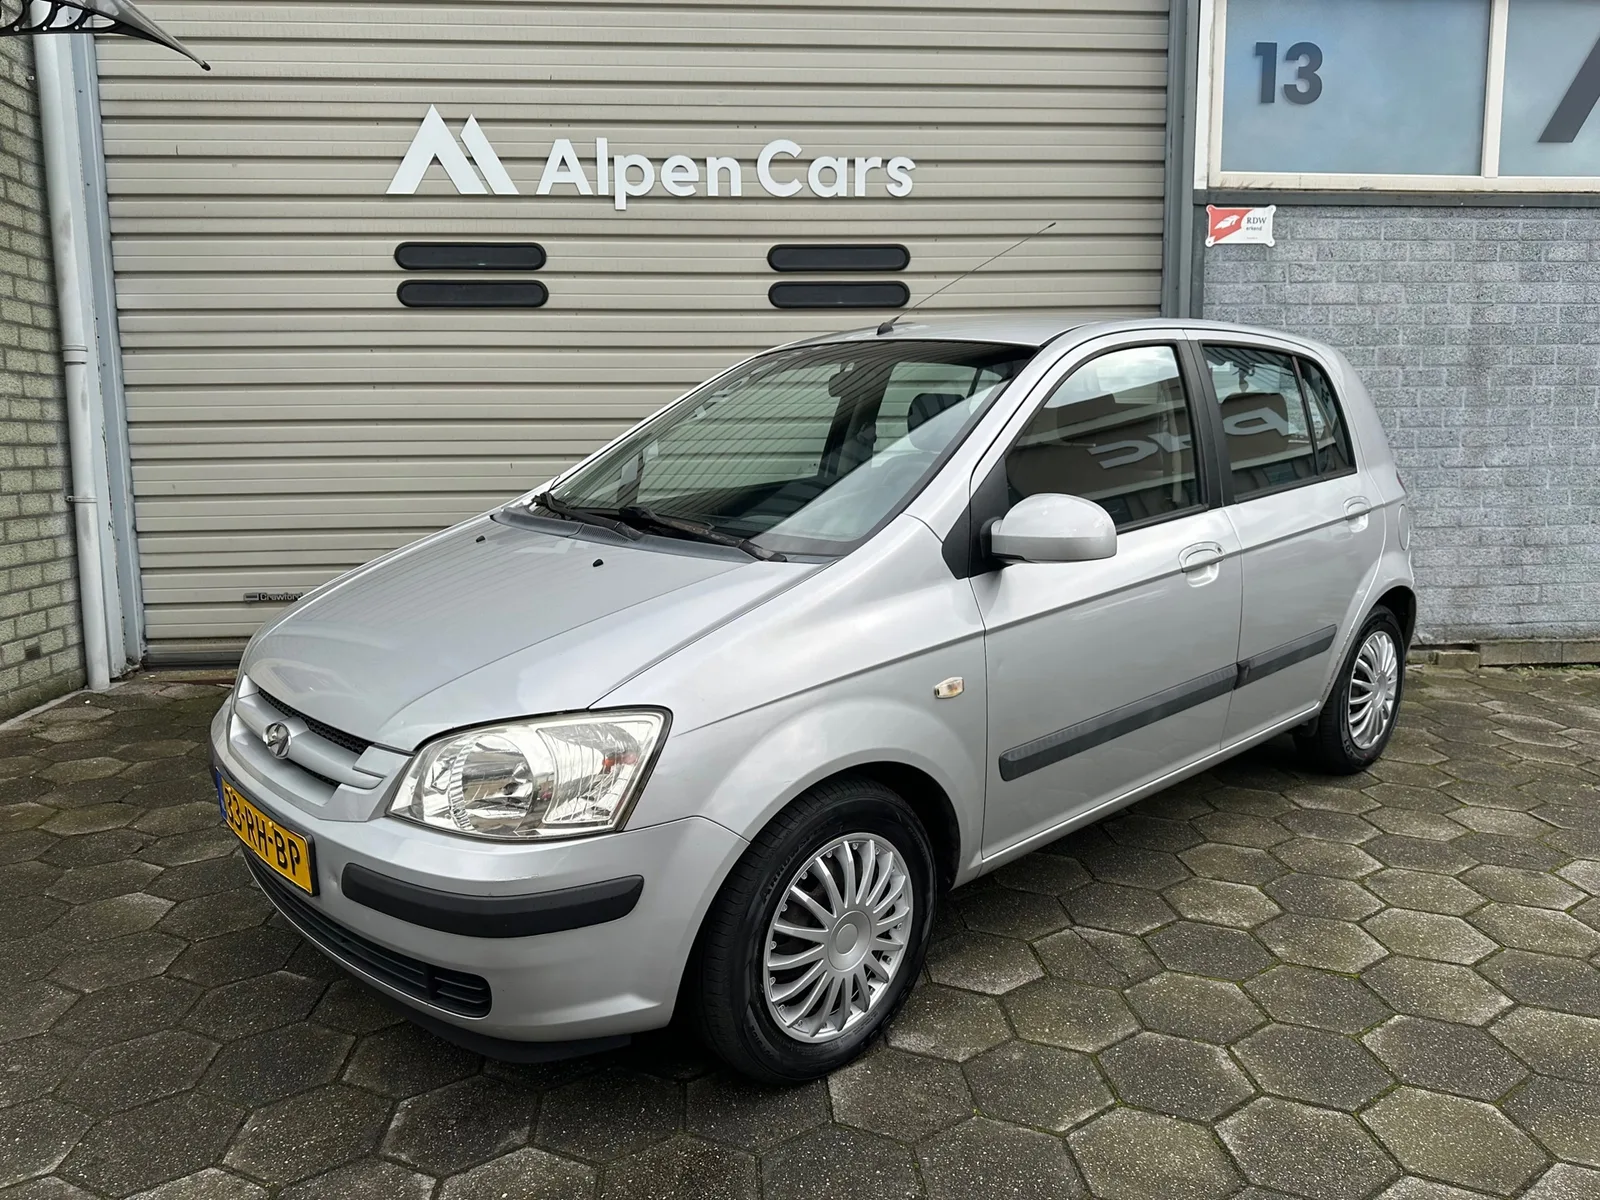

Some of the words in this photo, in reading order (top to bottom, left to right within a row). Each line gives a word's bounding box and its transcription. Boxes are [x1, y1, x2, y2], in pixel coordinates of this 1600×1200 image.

[1255, 41, 1323, 105] 13
[535, 137, 742, 211] Alpen
[756, 139, 917, 198] Cars
[1246, 216, 1267, 224] RDW
[224, 786, 301, 877] 33-RH-BP
